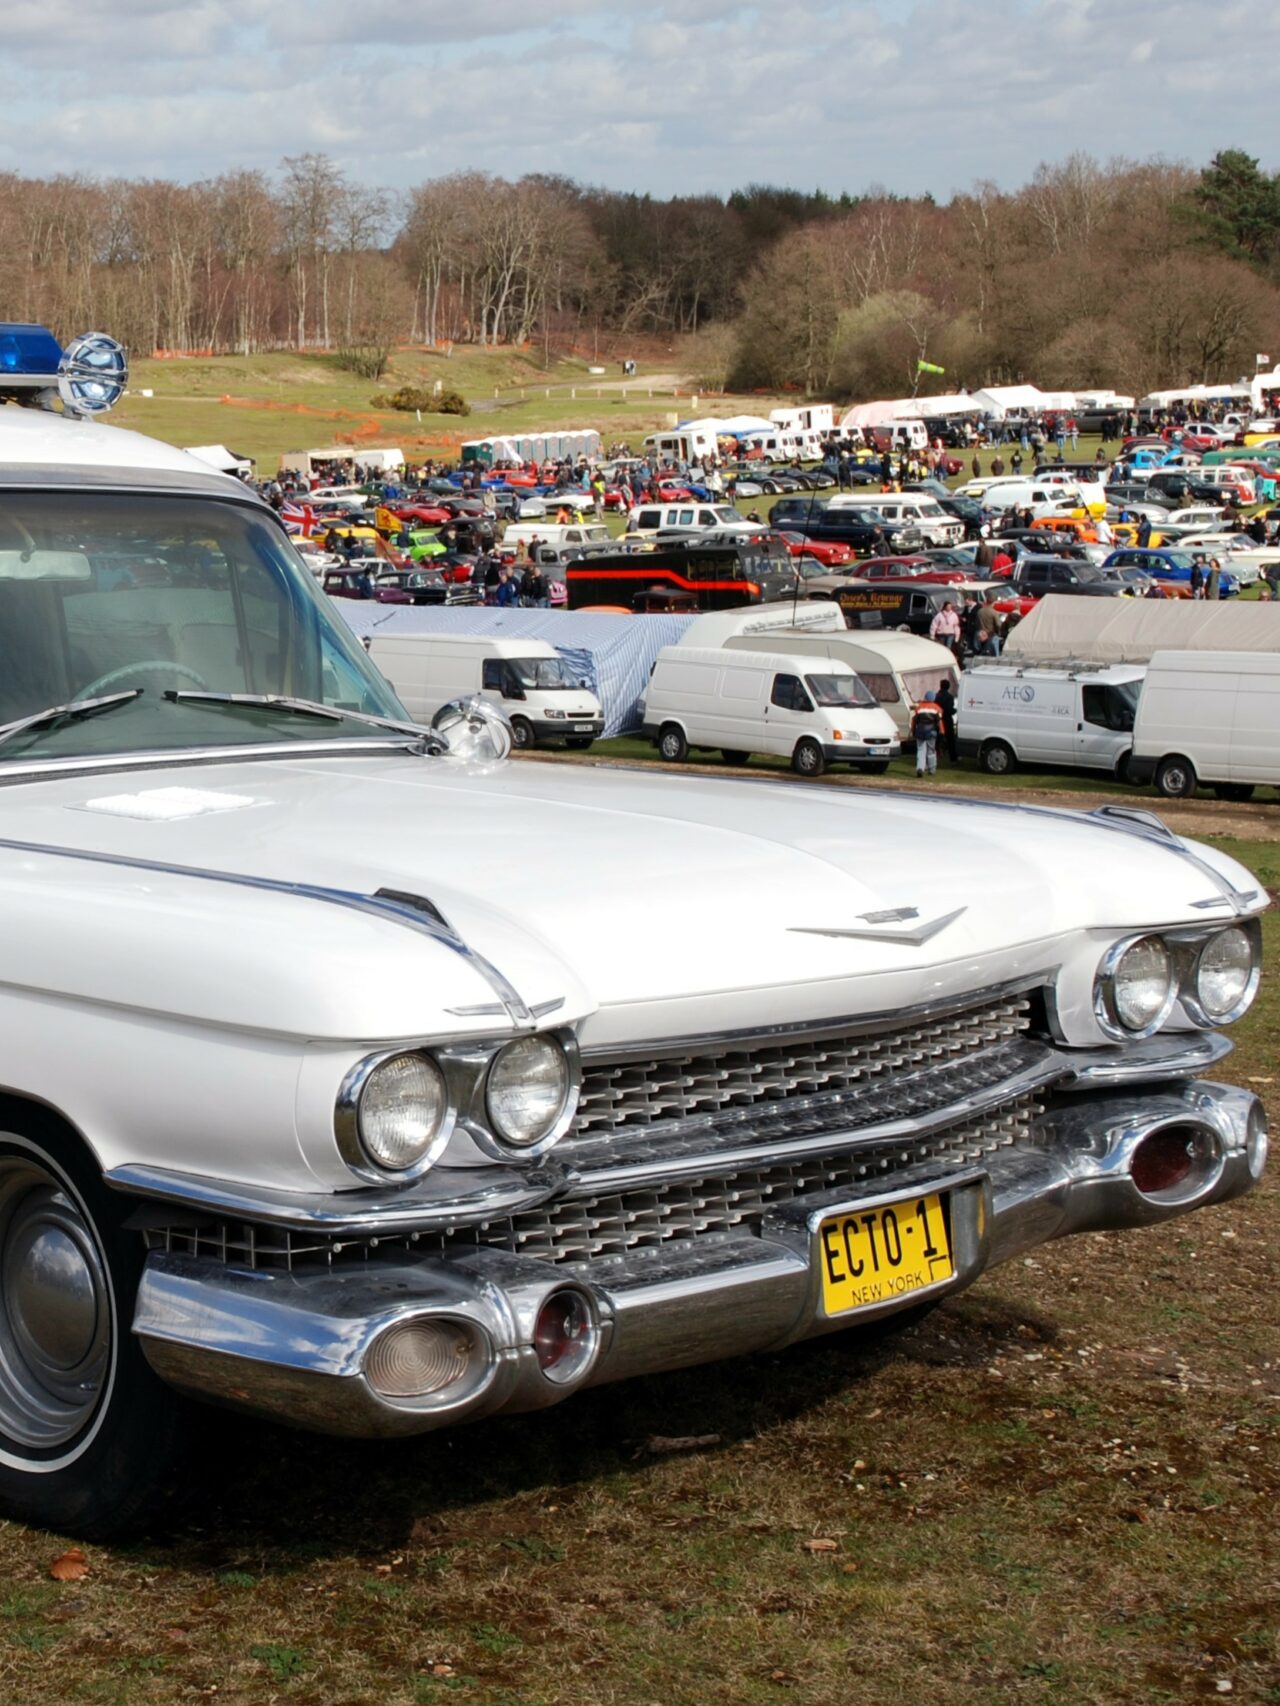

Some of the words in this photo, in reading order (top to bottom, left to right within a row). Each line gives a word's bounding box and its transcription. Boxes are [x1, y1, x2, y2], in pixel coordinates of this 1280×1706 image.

[821, 1199, 938, 1285] ECTO-1
[851, 1283, 882, 1305] NEW
[887, 1271, 925, 1295] YORK
